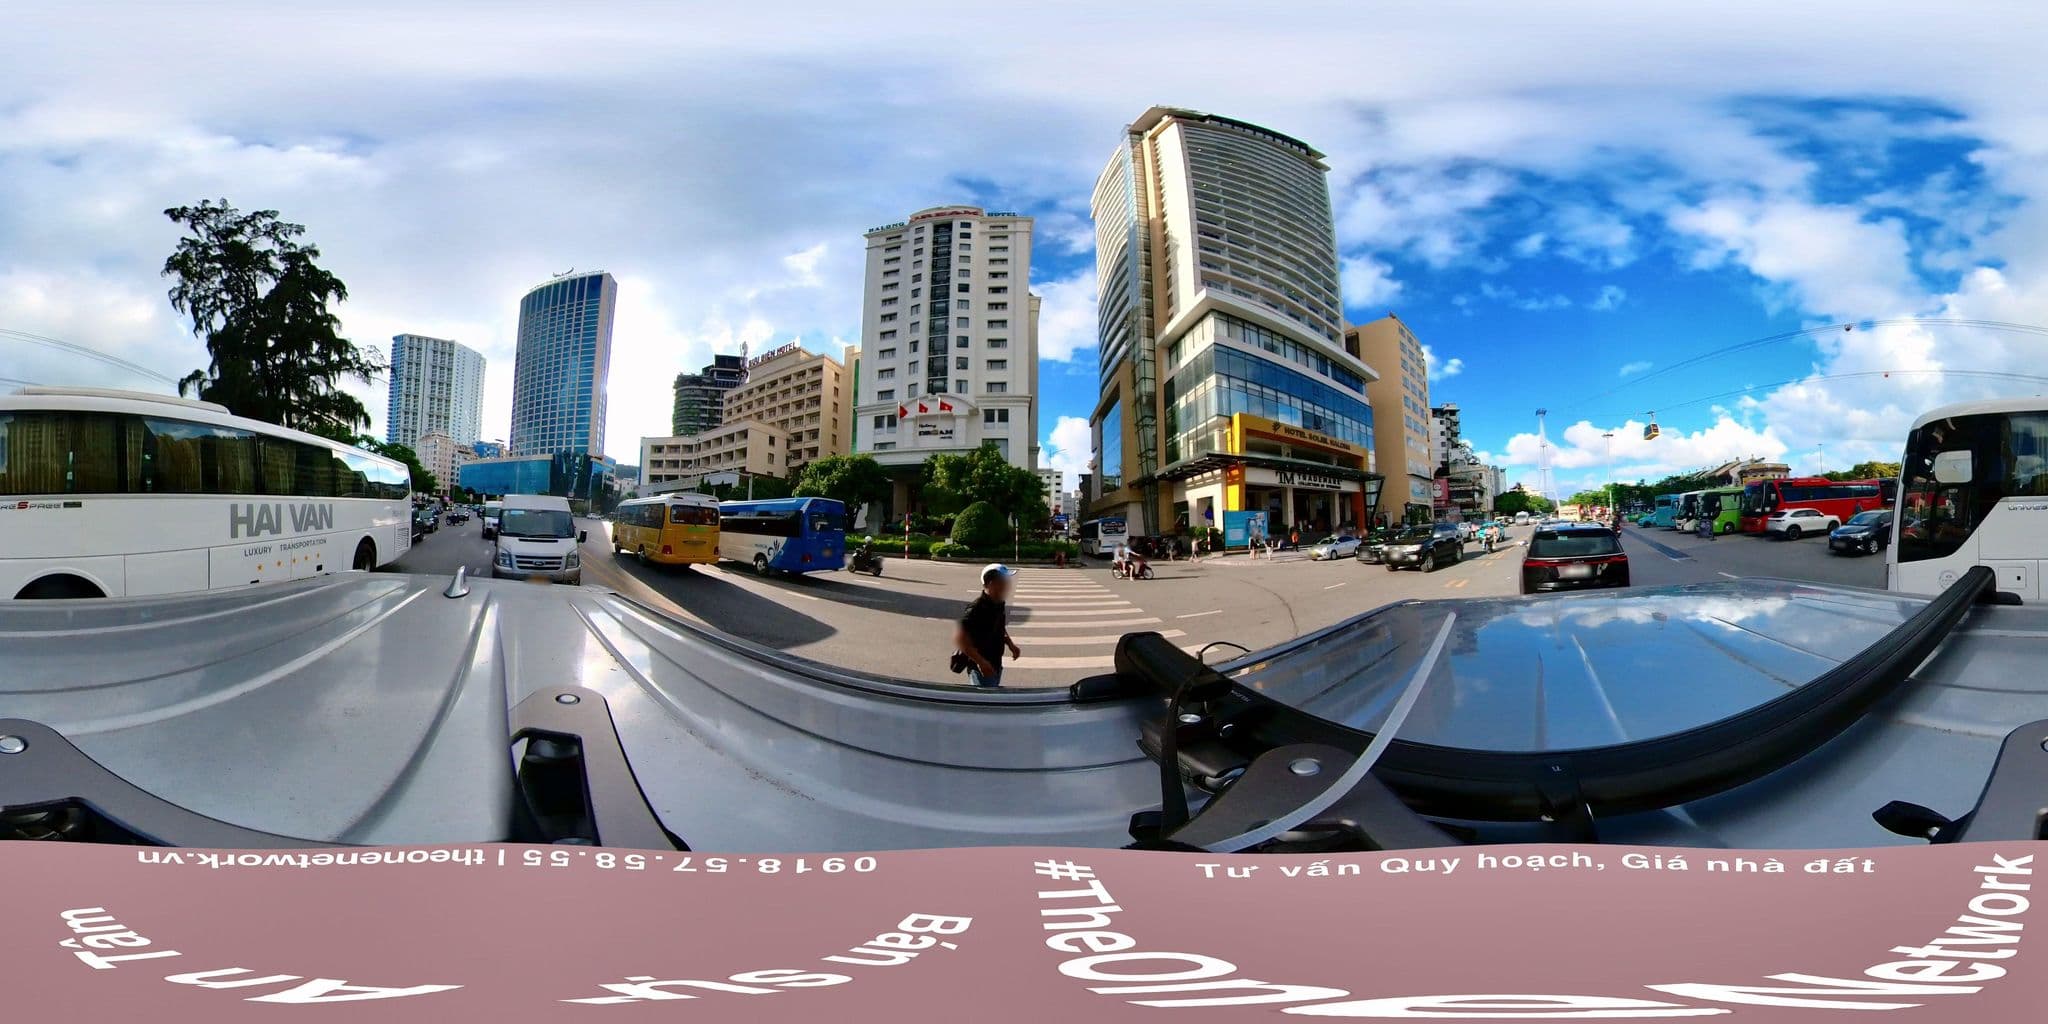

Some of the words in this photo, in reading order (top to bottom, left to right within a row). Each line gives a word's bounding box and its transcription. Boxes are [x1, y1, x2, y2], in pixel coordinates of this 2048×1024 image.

[1284, 426, 1308, 439] HOTEL
[230, 503, 282, 539] HAI
[289, 503, 334, 532] VAN
[244, 545, 273, 558] LUXURY
[279, 539, 327, 552] TRANSPORTATION
